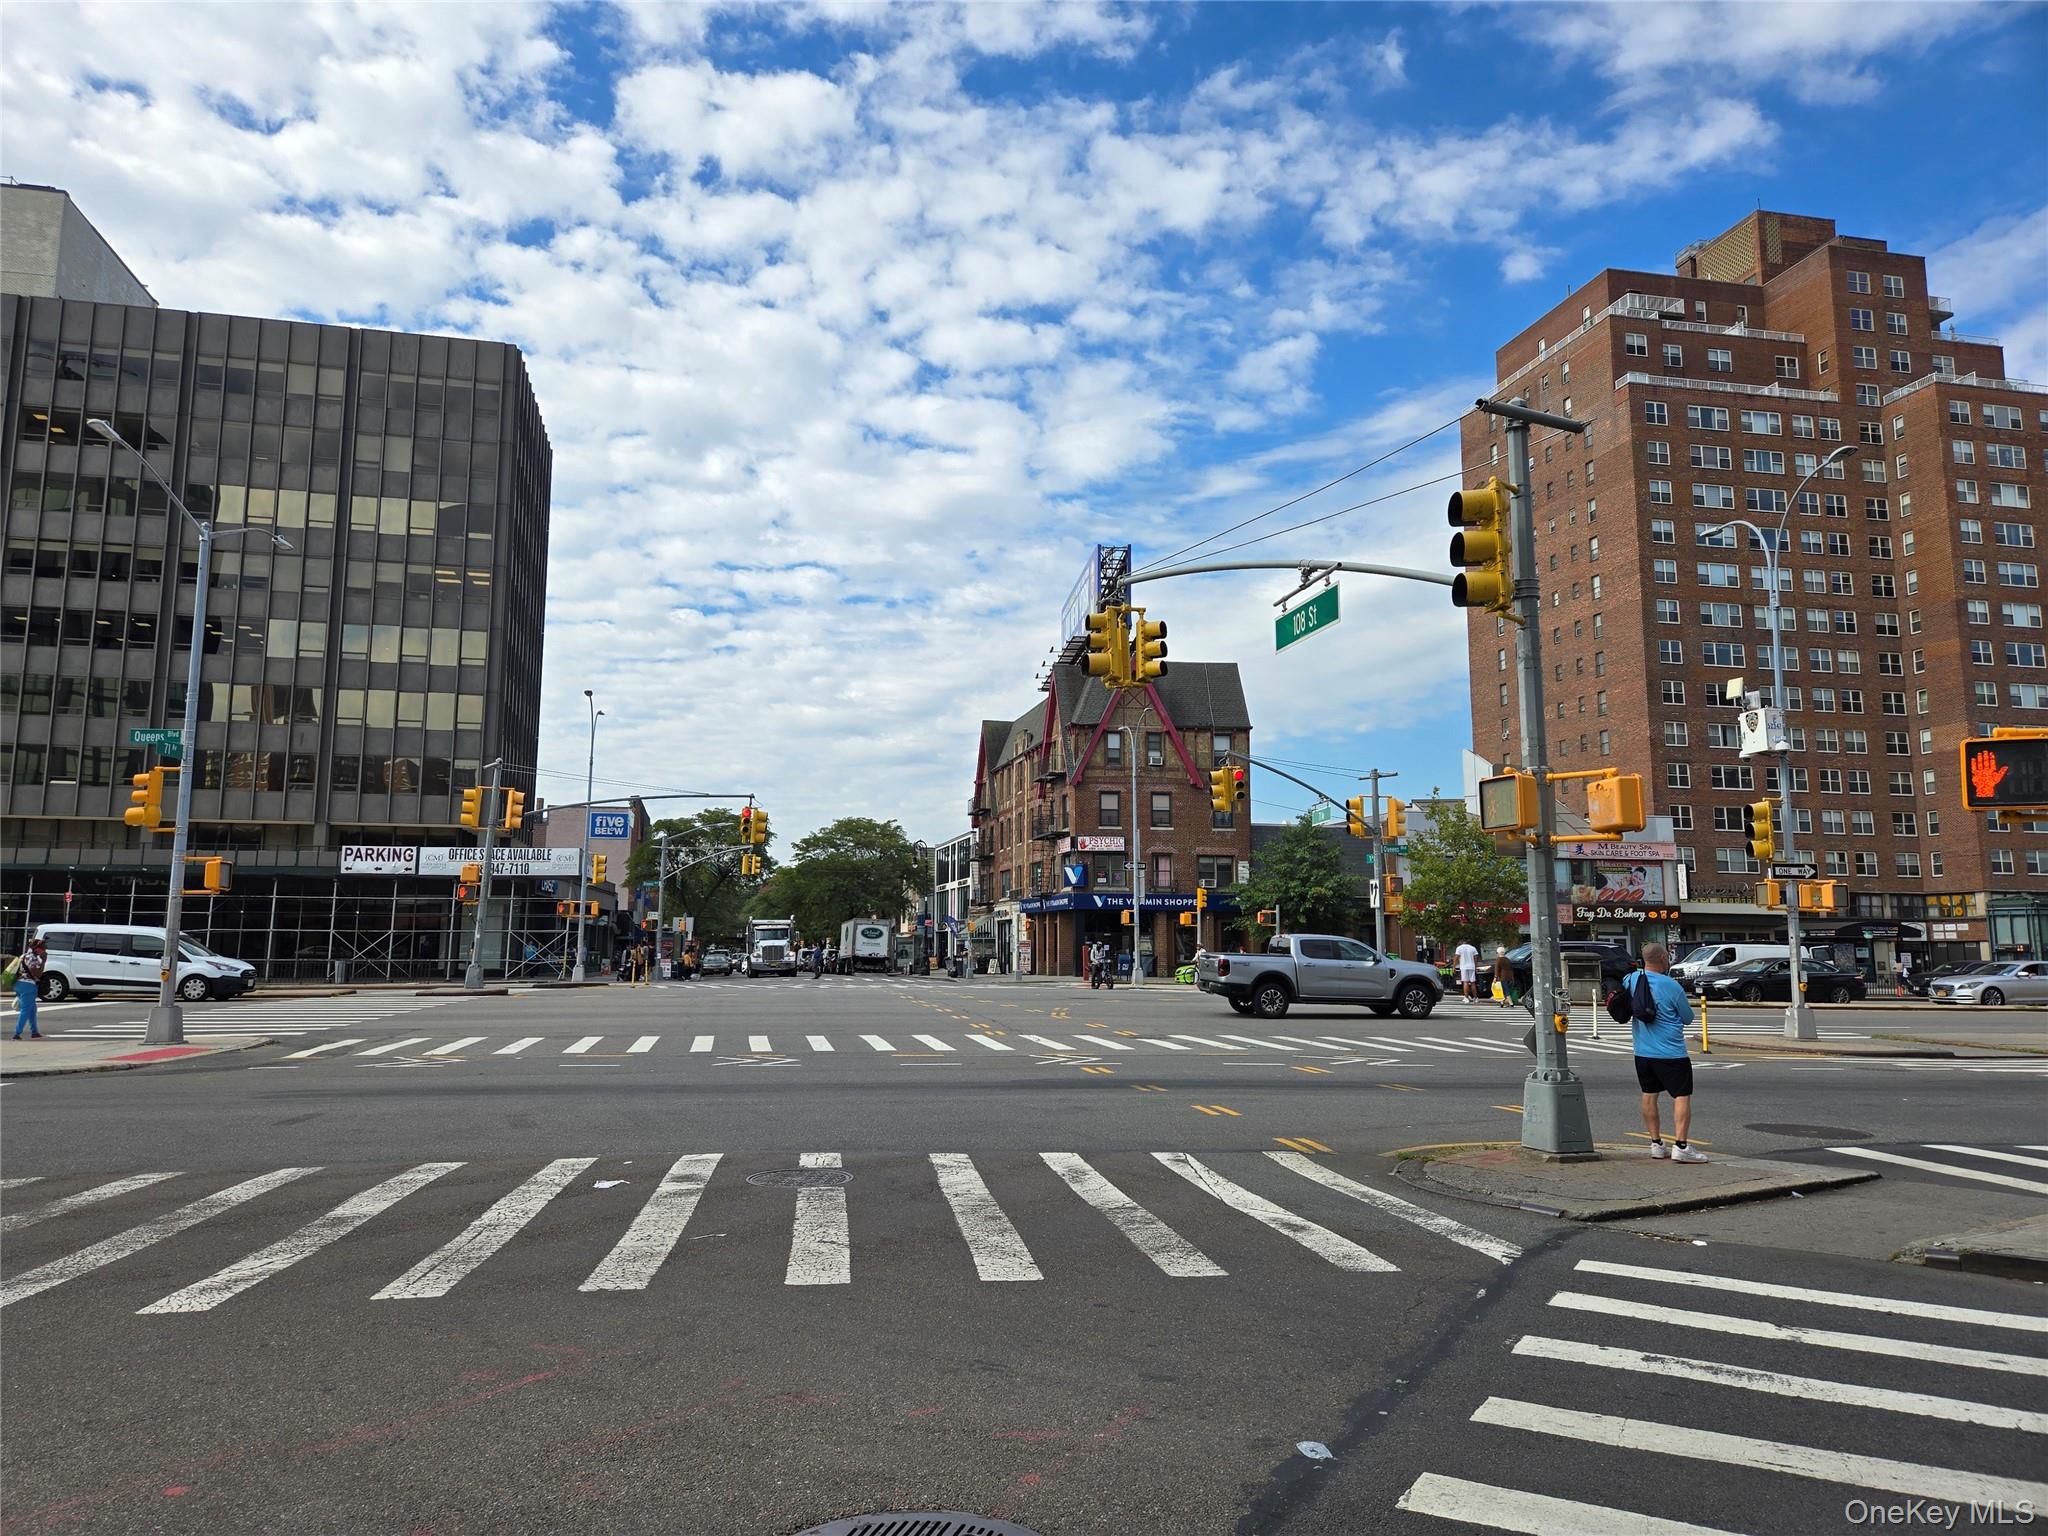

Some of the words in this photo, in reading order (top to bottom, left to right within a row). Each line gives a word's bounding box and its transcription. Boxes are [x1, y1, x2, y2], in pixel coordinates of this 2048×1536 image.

[1293, 611, 1306, 636] 108
[1308, 604, 1317, 627] St
[134, 731, 165, 742] Queens
[164, 743, 171, 755] 71
[595, 816, 624, 827] five
[1089, 837, 1124, 845] PSYCHIC
[344, 847, 414, 862] PARKING
[448, 848, 478, 860] OFFICE
[479, 848, 506, 860] SACE
[506, 848, 552, 860] AVAILABLE
[1164, 898, 1198, 906] SHOPPE
[1576, 906, 1595, 921] Fay
[1596, 906, 1612, 918] Da
[1613, 907, 1647, 922] Bakery
